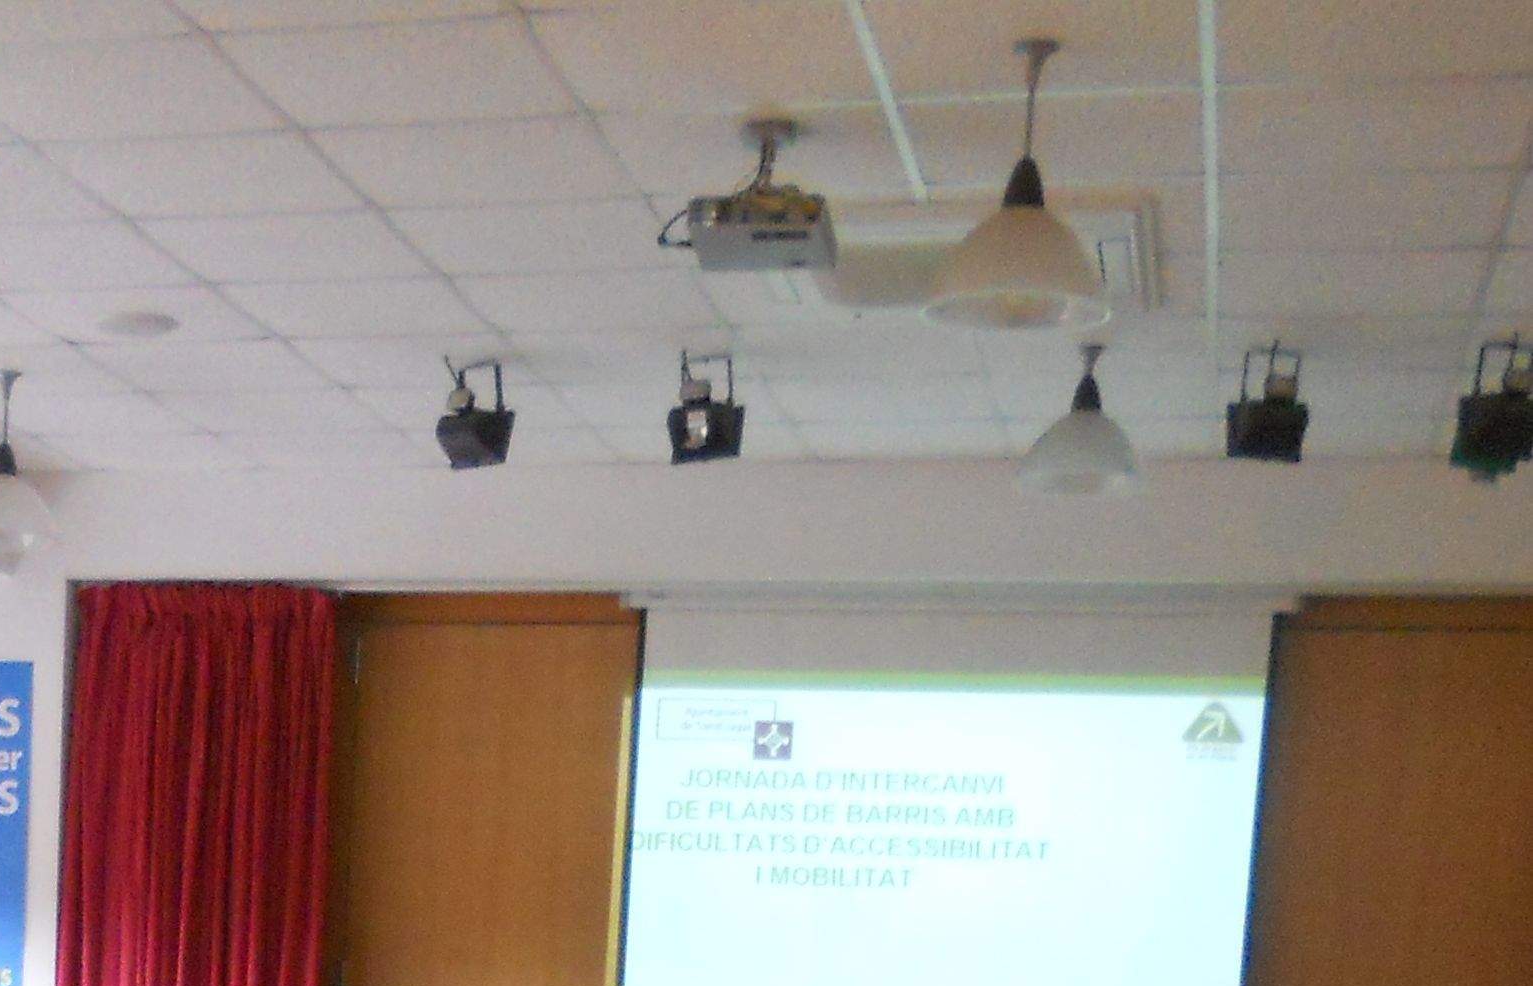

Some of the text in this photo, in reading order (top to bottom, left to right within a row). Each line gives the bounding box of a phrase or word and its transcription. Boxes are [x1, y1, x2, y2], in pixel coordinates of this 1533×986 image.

[680, 768, 806, 789] JORNADA
[666, 800, 1015, 828] DE PLANS DE BARRIS AMB
[802, 834, 1050, 861] D'ACCESSIBILITAT
[755, 866, 913, 888] I MOBILITAT
